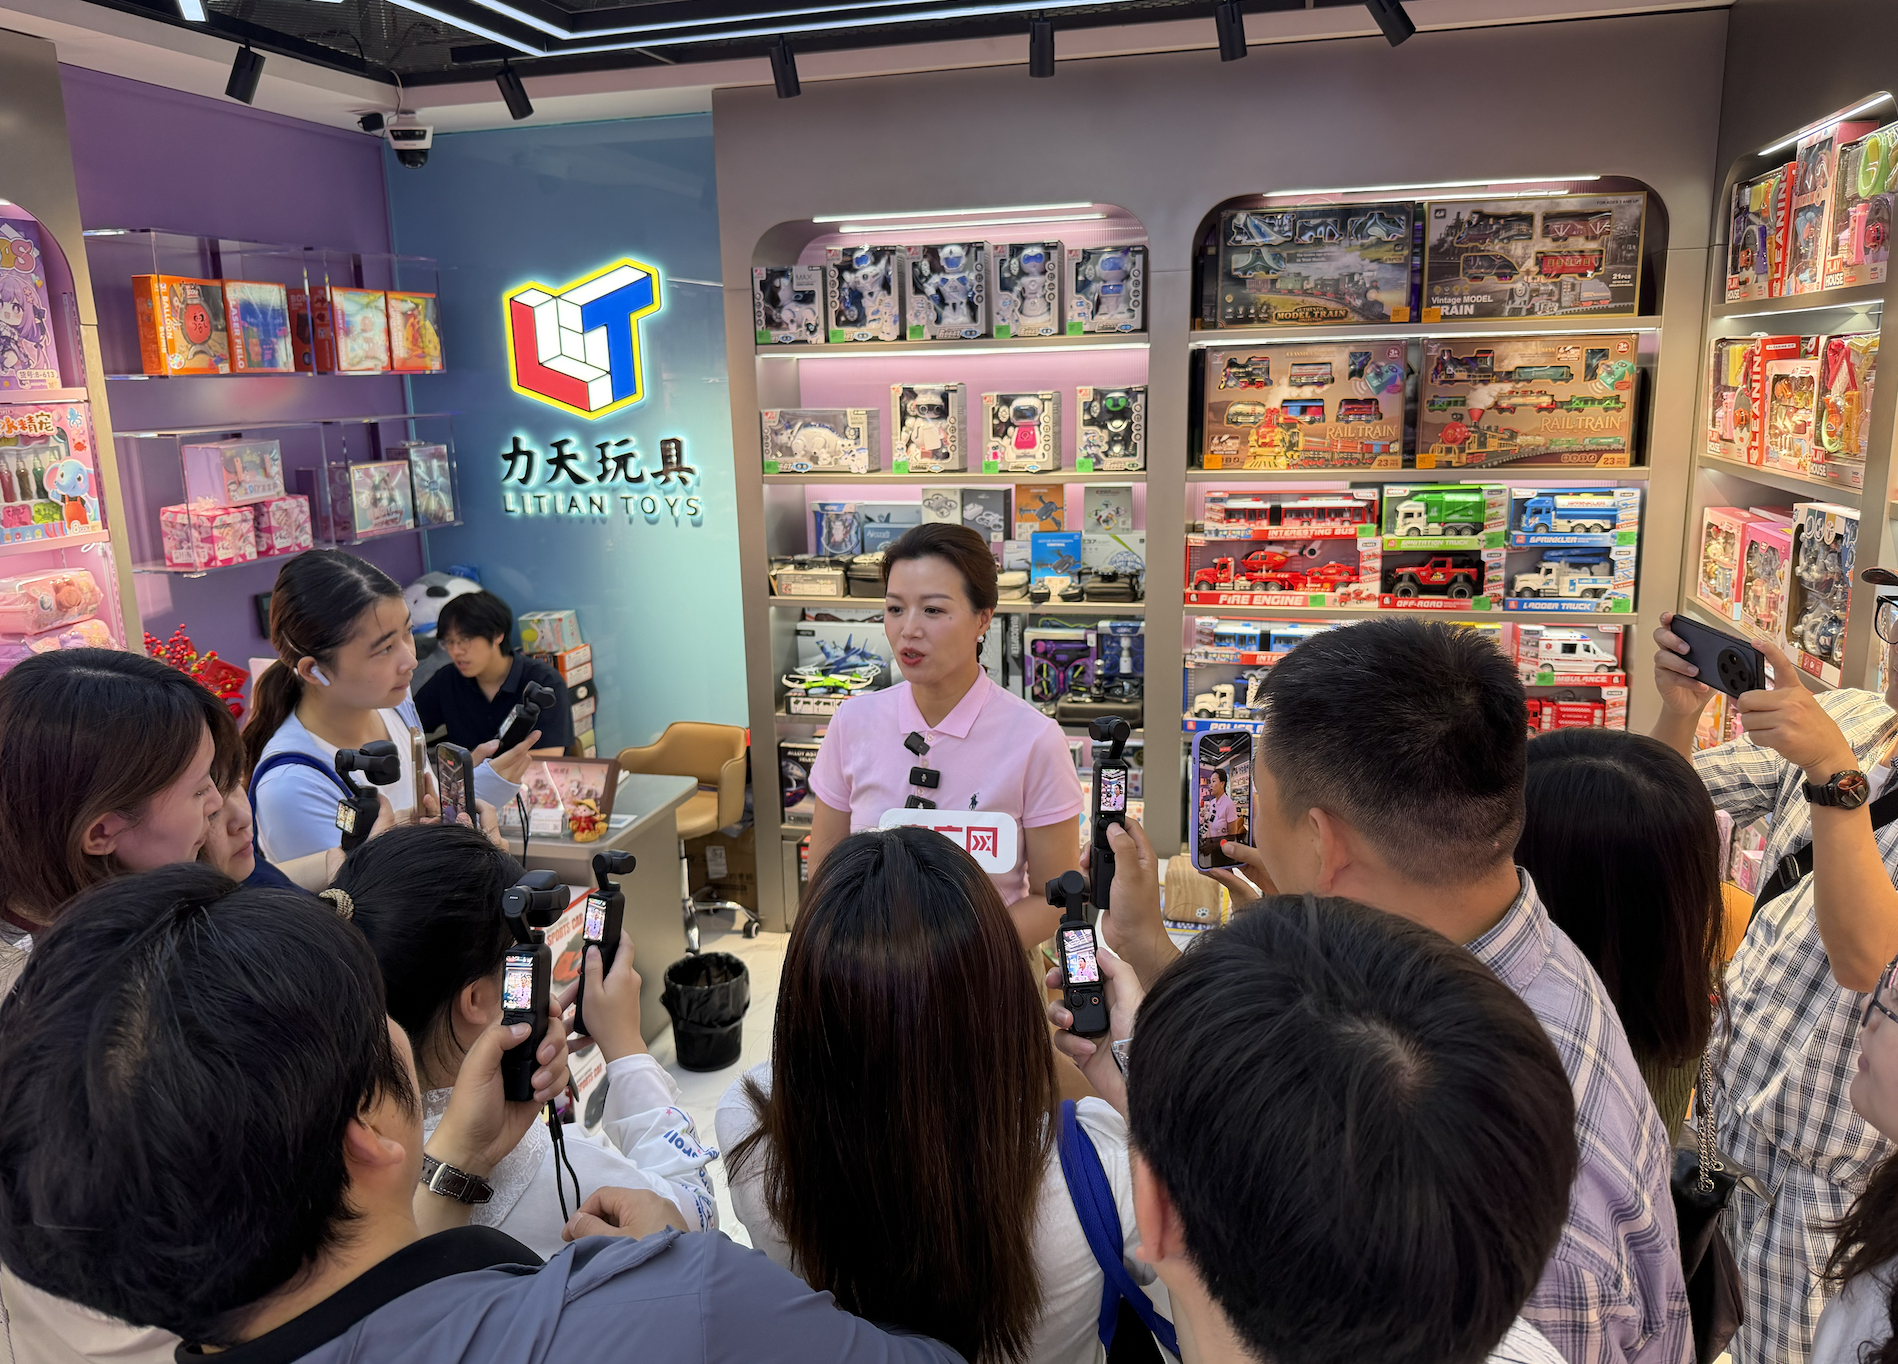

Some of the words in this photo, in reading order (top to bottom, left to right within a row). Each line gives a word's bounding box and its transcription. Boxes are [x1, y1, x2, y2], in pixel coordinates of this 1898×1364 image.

[1827, 258, 1842, 273] PLAY
[1825, 274, 1844, 287] HOUSE
[1431, 296, 1462, 305] Vintage
[1463, 295, 1494, 304] MODEL
[1276, 311, 1311, 320] MODEL
[1312, 309, 1347, 319] TRAIN
[1431, 305, 1475, 316] RAIN
[229, 300, 241, 336] LASER
[501, 436, 700, 487] 力天玩具
[1376, 459, 1389, 467] 23
[1603, 457, 1615, 465] 23
[504, 493, 609, 516] LITIAN
[620, 494, 703, 519] TOYS
[1267, 529, 1332, 537] INTERESTING
[1334, 527, 1355, 536] BUS
[1218, 595, 1248, 605] FIRE
[1252, 594, 1305, 605] ENGINE
[1396, 600, 1443, 608] OFF-ROAD
[547, 921, 571, 946] SPORTS
[571, 912, 584, 930] CAR
